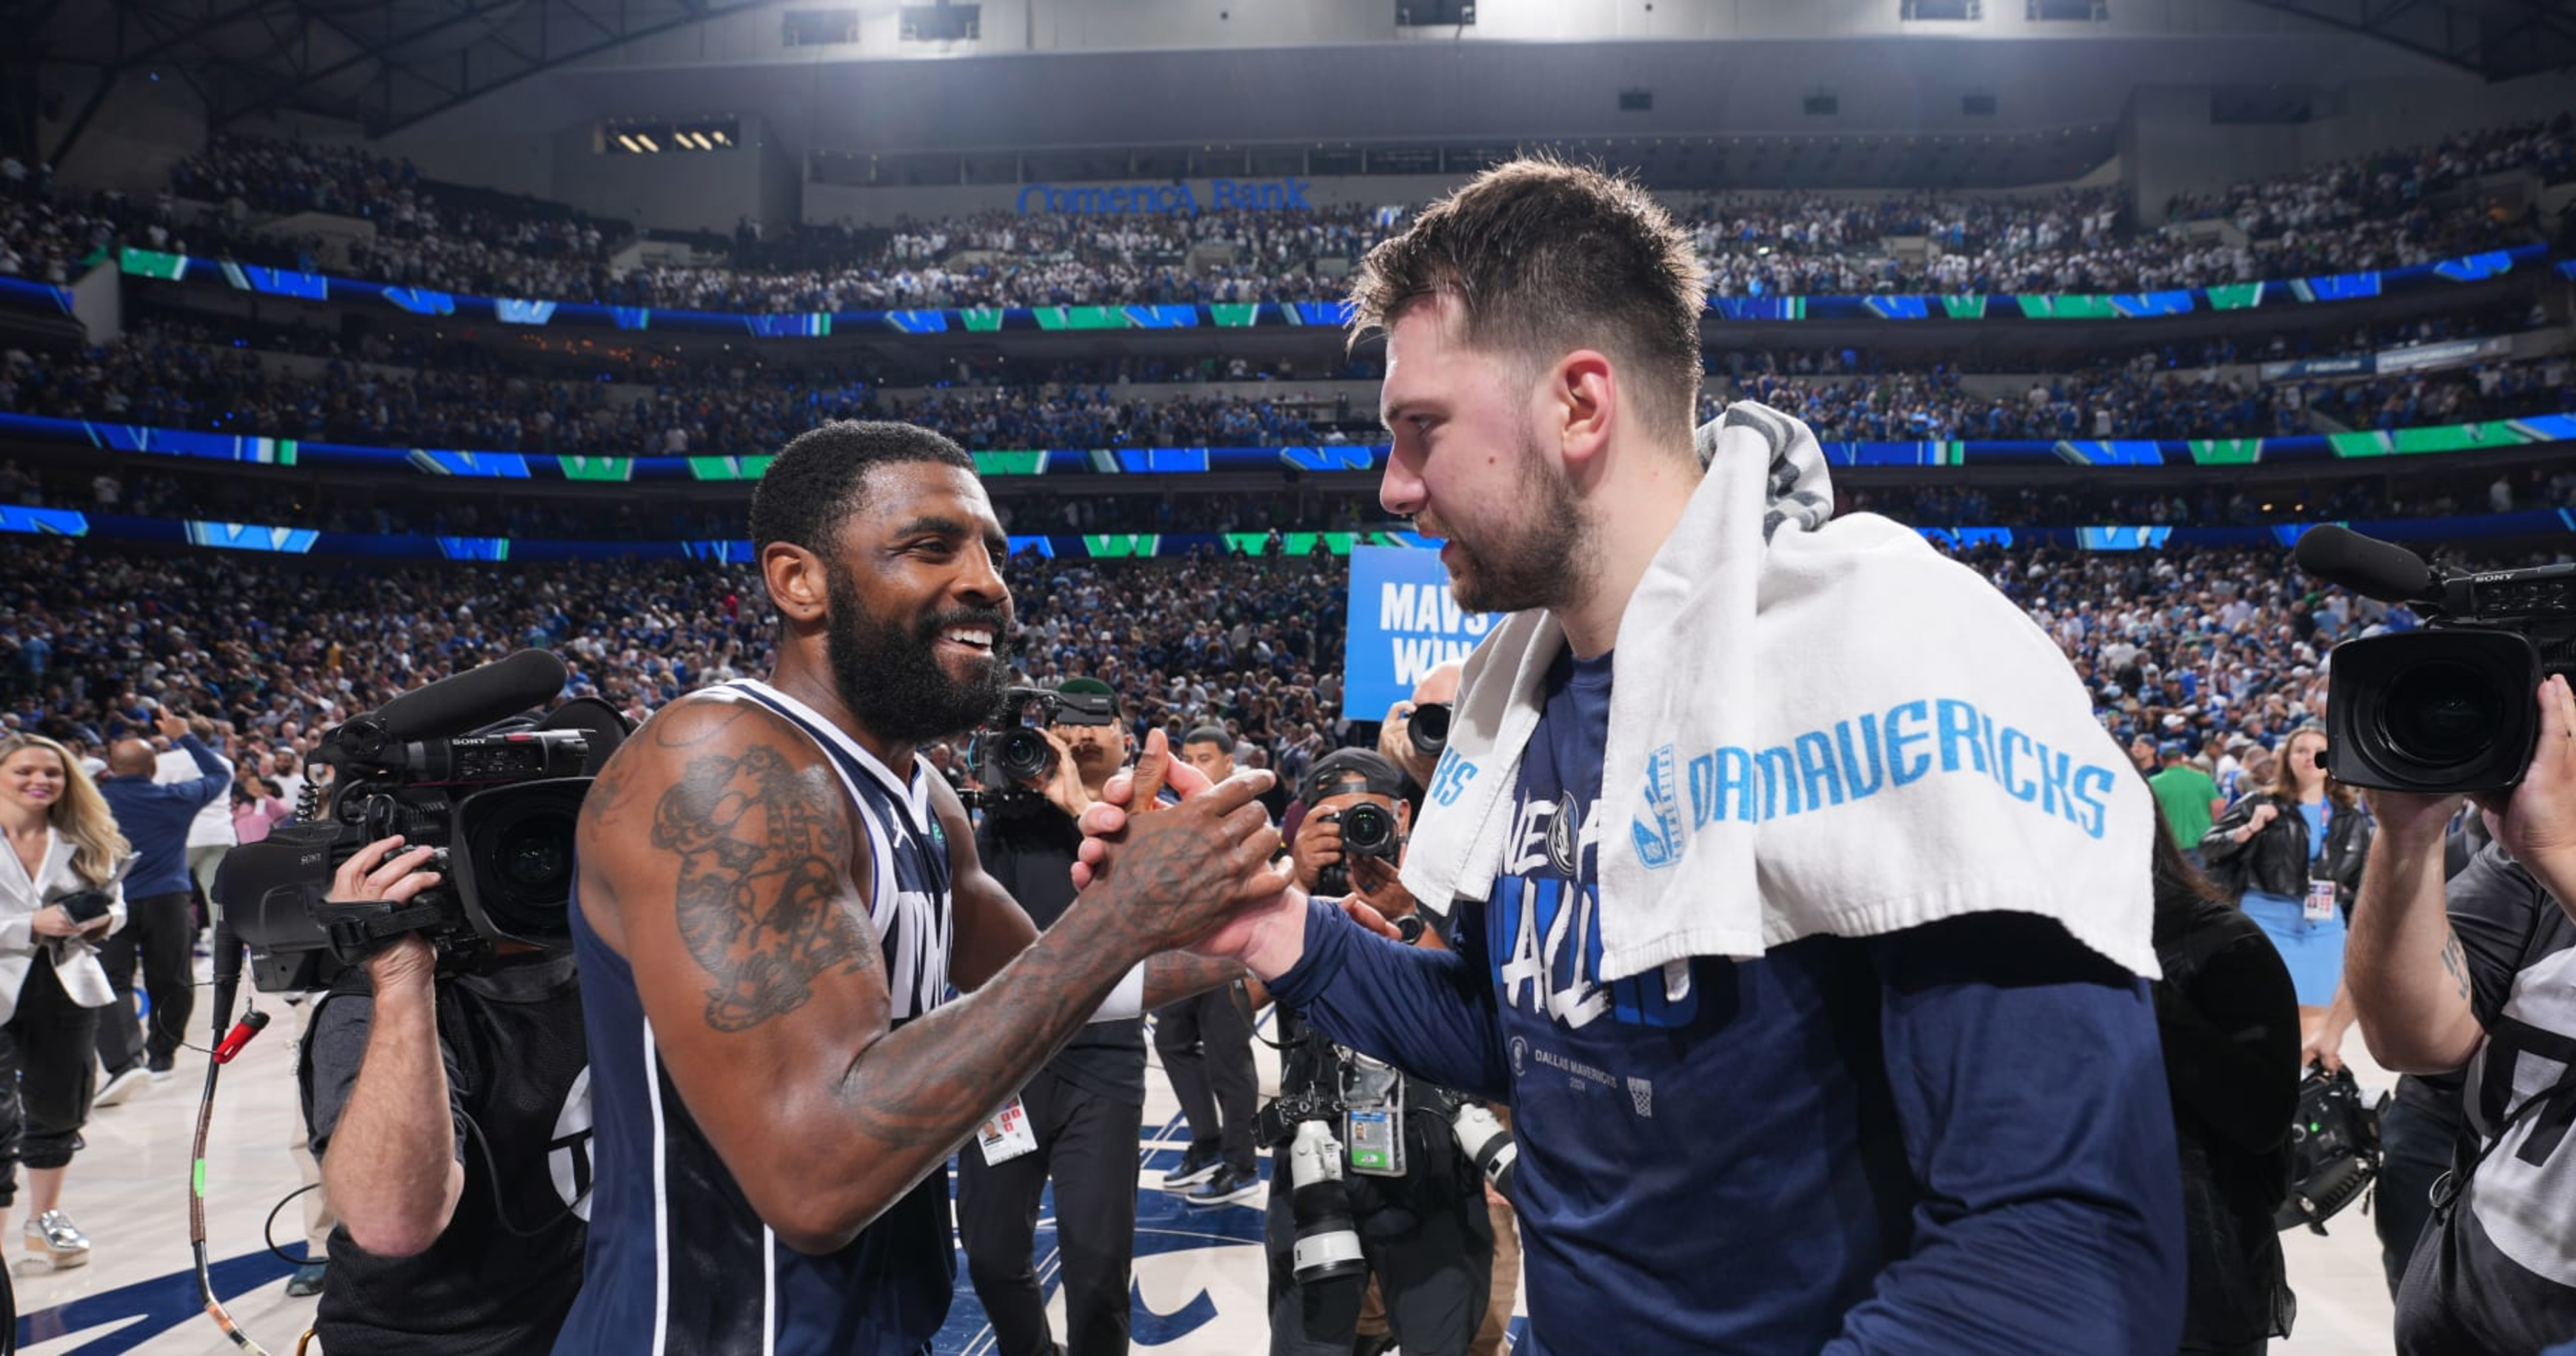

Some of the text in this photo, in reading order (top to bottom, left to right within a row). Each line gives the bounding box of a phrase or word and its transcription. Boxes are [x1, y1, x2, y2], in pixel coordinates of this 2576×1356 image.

[1211, 175, 1313, 212] Bank
[2475, 573, 2514, 582] SONY
[1501, 876, 1613, 1029] ALL
[1535, 1049, 1569, 1071] DALLAS
